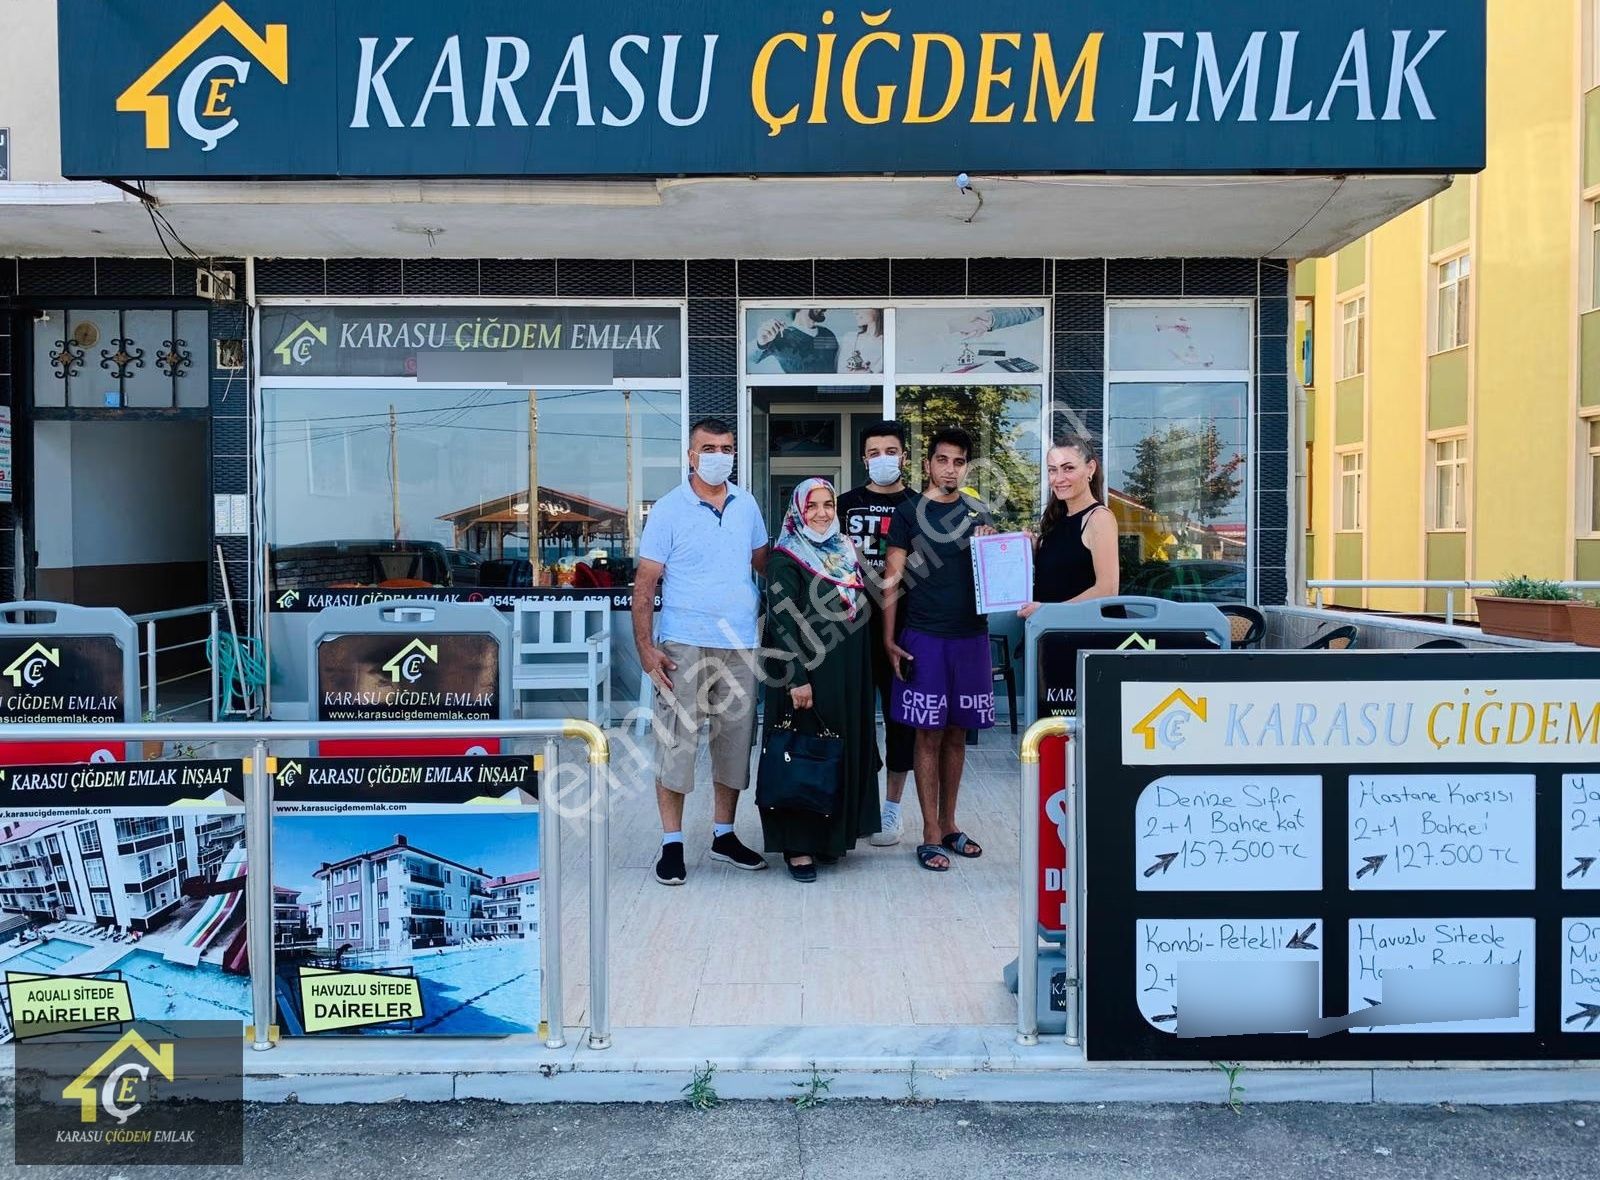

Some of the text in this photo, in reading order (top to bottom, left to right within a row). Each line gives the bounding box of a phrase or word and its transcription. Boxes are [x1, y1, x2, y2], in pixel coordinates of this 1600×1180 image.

[350, 8, 1448, 136] KARASU ÇİĞDEM EMLAK
[339, 317, 664, 351] KARASU ÇİĞDEM EMLAK
[307, 594, 359, 607] KARASU
[7, 694, 64, 711] ÇİĞDEM
[68, 695, 118, 710] EMLAK
[324, 689, 494, 707] KARASU ÇİĞDEM EMLAK
[902, 689, 948, 710] CREA
[1047, 688, 1077, 701] KAR
[902, 704, 940, 725] TIVE
[1224, 687, 1600, 750] KARASU ÇİĞDEM
[11, 766, 233, 792] KARASU ÇİĞDEM EMLAK İNŞAAT
[308, 763, 529, 787] KARASU ÇİĞDEM EMLAK İNŞAAT
[276, 803, 407, 813] www.karasucigdememlak.com
[1180, 839, 1275, 869] 157.500
[1395, 842, 1483, 873] 127.500
[1143, 963, 1177, 992] 2+
[27, 986, 115, 1002] AQUALI SİTEDE
[311, 982, 412, 997] HAVUZLU SİTEDE
[22, 1005, 120, 1024] DAİRELER
[315, 999, 412, 1018] DAİRELER
